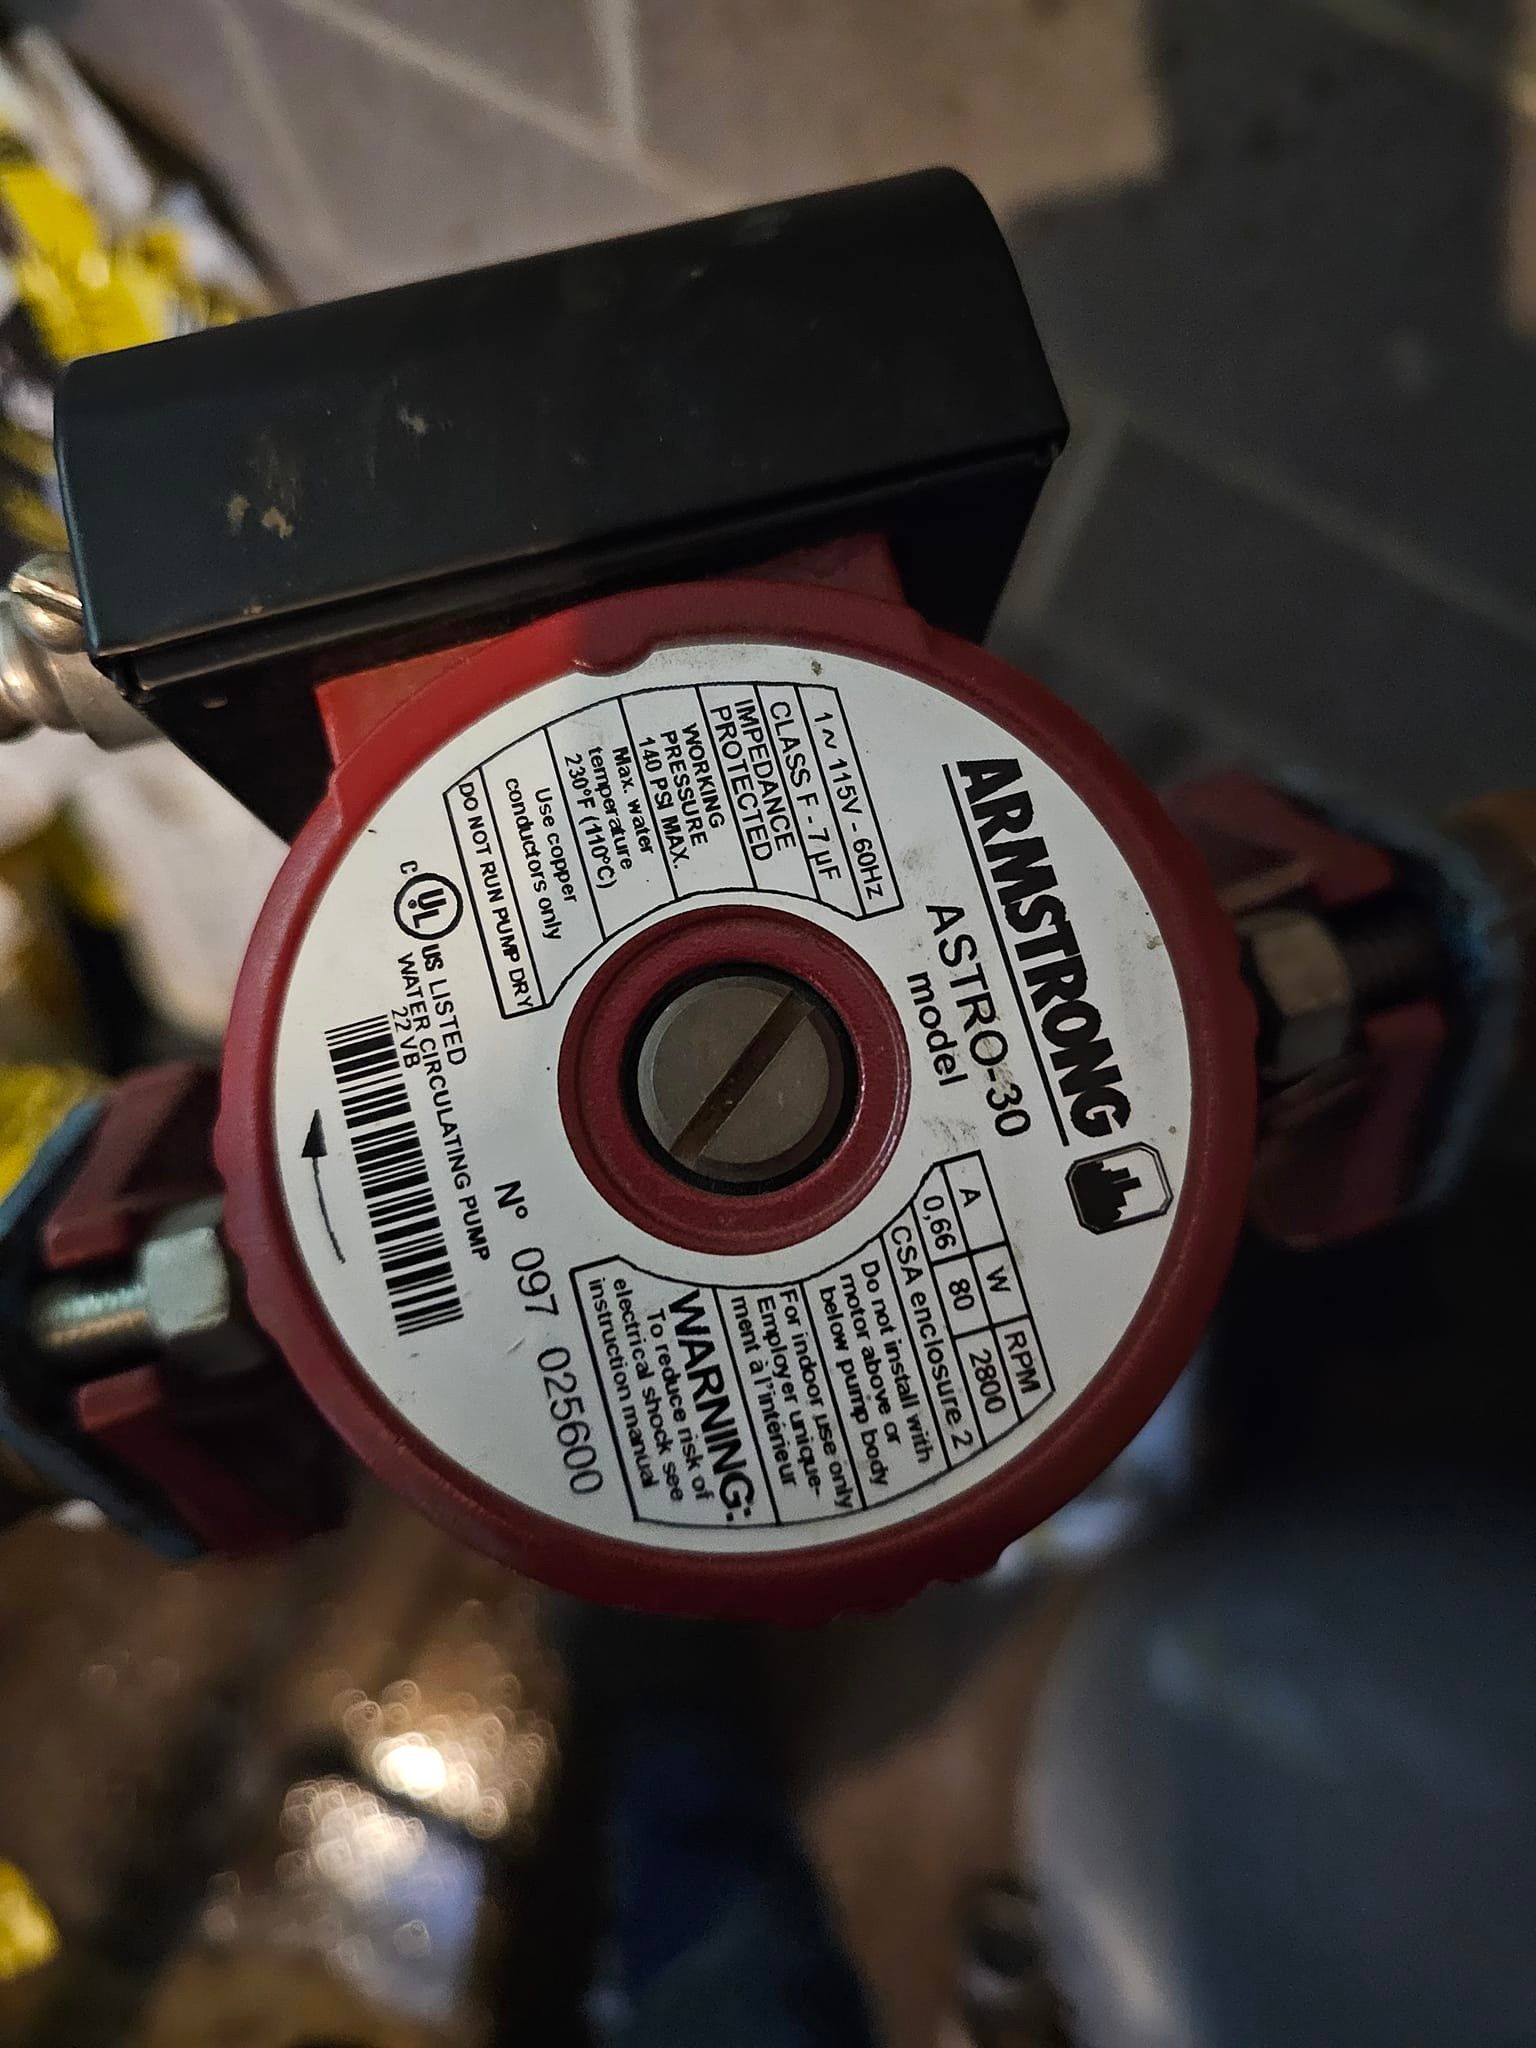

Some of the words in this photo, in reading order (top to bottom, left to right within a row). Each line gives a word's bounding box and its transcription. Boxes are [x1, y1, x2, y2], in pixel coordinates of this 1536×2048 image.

[458, 781, 479, 812] DO
[638, 736, 663, 773] 140
[649, 776, 675, 811] PSI
[659, 729, 709, 847] PRESSURE
[681, 721, 726, 829] WORKING
[709, 704, 773, 862] PROTECTED
[733, 698, 797, 852] IMPEDANCE
[769, 700, 812, 788] CLASS
[467, 815, 493, 855] NOT
[534, 787, 556, 828] Use
[546, 832, 578, 903] copper
[587, 746, 633, 870] temperature
[611, 745, 635, 794] Max.
[626, 798, 655, 854] water
[660, 814, 690, 870] MAX.
[796, 792, 820, 807] F
[807, 826, 831, 843] 7
[828, 758, 863, 814] 115V
[852, 837, 884, 901] 60Hz
[479, 860, 505, 903] RUN
[505, 778, 548, 893] conductors
[537, 896, 563, 940] only
[491, 906, 521, 963] PUMP
[508, 967, 534, 1009] DRY
[955, 758, 1132, 1139] ARMSTRONG
[391, 1005, 413, 1033] 22
[399, 1034, 422, 1069] VB
[428, 978, 467, 1066] LISTED
[906, 971, 969, 1087] model
[925, 905, 1032, 1137] ASTRO-30
[397, 951, 432, 1033] WATER
[418, 1037, 472, 1190] CIRCULATING
[458, 1194, 491, 1261] PUMP
[646, 1307, 667, 1339] To
[860, 1259, 881, 1294] Do
[870, 1297, 897, 1337] not
[922, 1194, 957, 1251] 0,66
[948, 1277, 976, 1312] 80
[968, 1347, 1007, 1415] 2800
[958, 1188, 982, 1208] A
[985, 1264, 1012, 1293] W
[1003, 1330, 1042, 1395] RPM
[511, 1247, 560, 1317] 097
[536, 1346, 604, 1496] 025600
[588, 1276, 632, 1402] instruction
[621, 1404, 660, 1489] manual
[654, 1343, 687, 1423] reduce
[730, 1295, 762, 1355] ment
[748, 1359, 769, 1376] à
[818, 1284, 850, 1352] below
[835, 1357, 872, 1425] pump
[860, 1427, 889, 1487] body
[839, 1272, 871, 1341] motor
[860, 1345, 892, 1416] above
[883, 1421, 902, 1445] or
[883, 1338, 921, 1410] install
[890, 1225, 924, 1287] CSA
[910, 1291, 963, 1428] enclosure
[950, 1429, 974, 1450] 2
[613, 1278, 656, 1381] electrical
[641, 1385, 674, 1457] shock
[662, 1461, 684, 1503] see
[667, 1286, 756, 1523] WARNING:
[756, 1294, 799, 1404] Employer
[788, 1409, 822, 1498] unique-
[778, 1287, 802, 1327] For
[791, 1331, 825, 1408] indoor
[811, 1413, 838, 1457] use
[828, 1460, 854, 1510] only
[905, 1412, 934, 1464] with
[677, 1426, 704, 1472] risk
[691, 1474, 715, 1501] of
